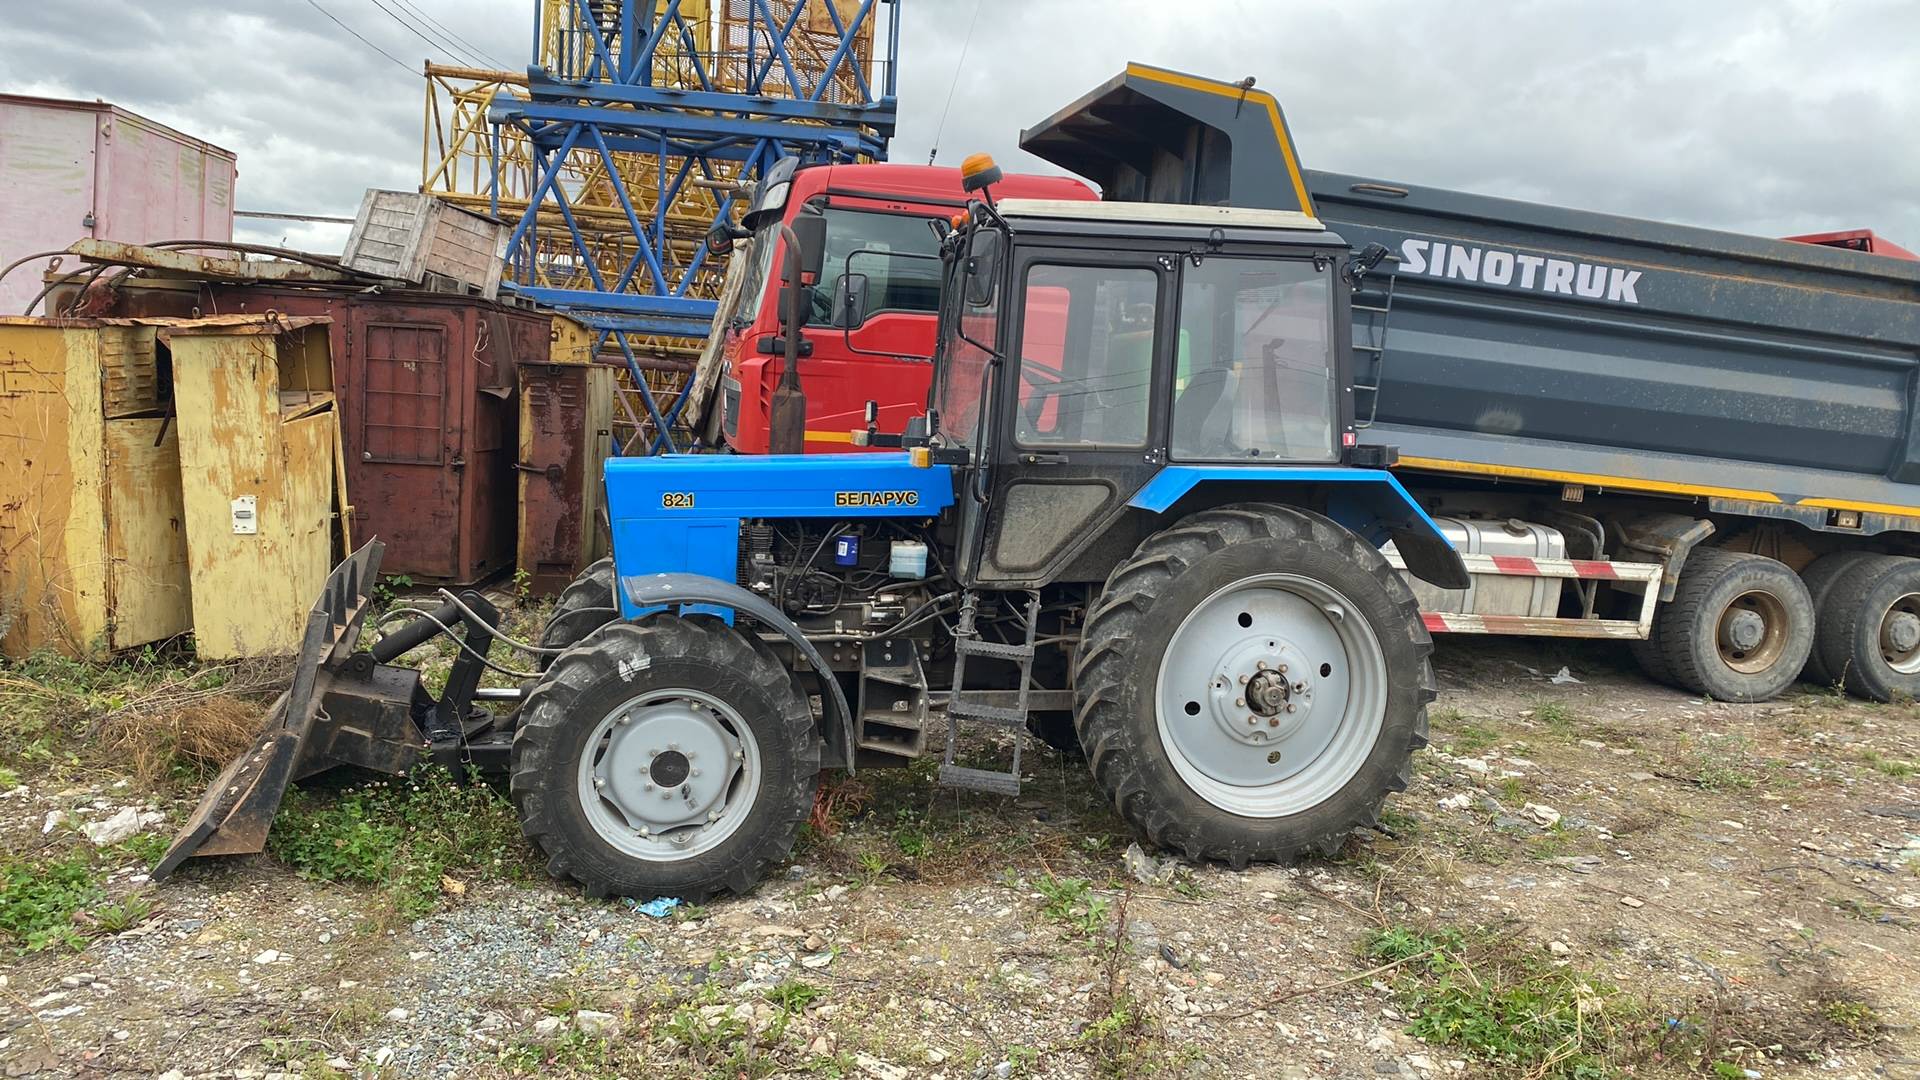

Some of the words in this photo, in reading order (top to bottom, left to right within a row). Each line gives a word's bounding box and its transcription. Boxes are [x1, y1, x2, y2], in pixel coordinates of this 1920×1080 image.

[1399, 239, 1642, 303] SINOTRUK
[662, 492, 694, 508] 82.1
[835, 491, 918, 507] БЕЛАРУС
